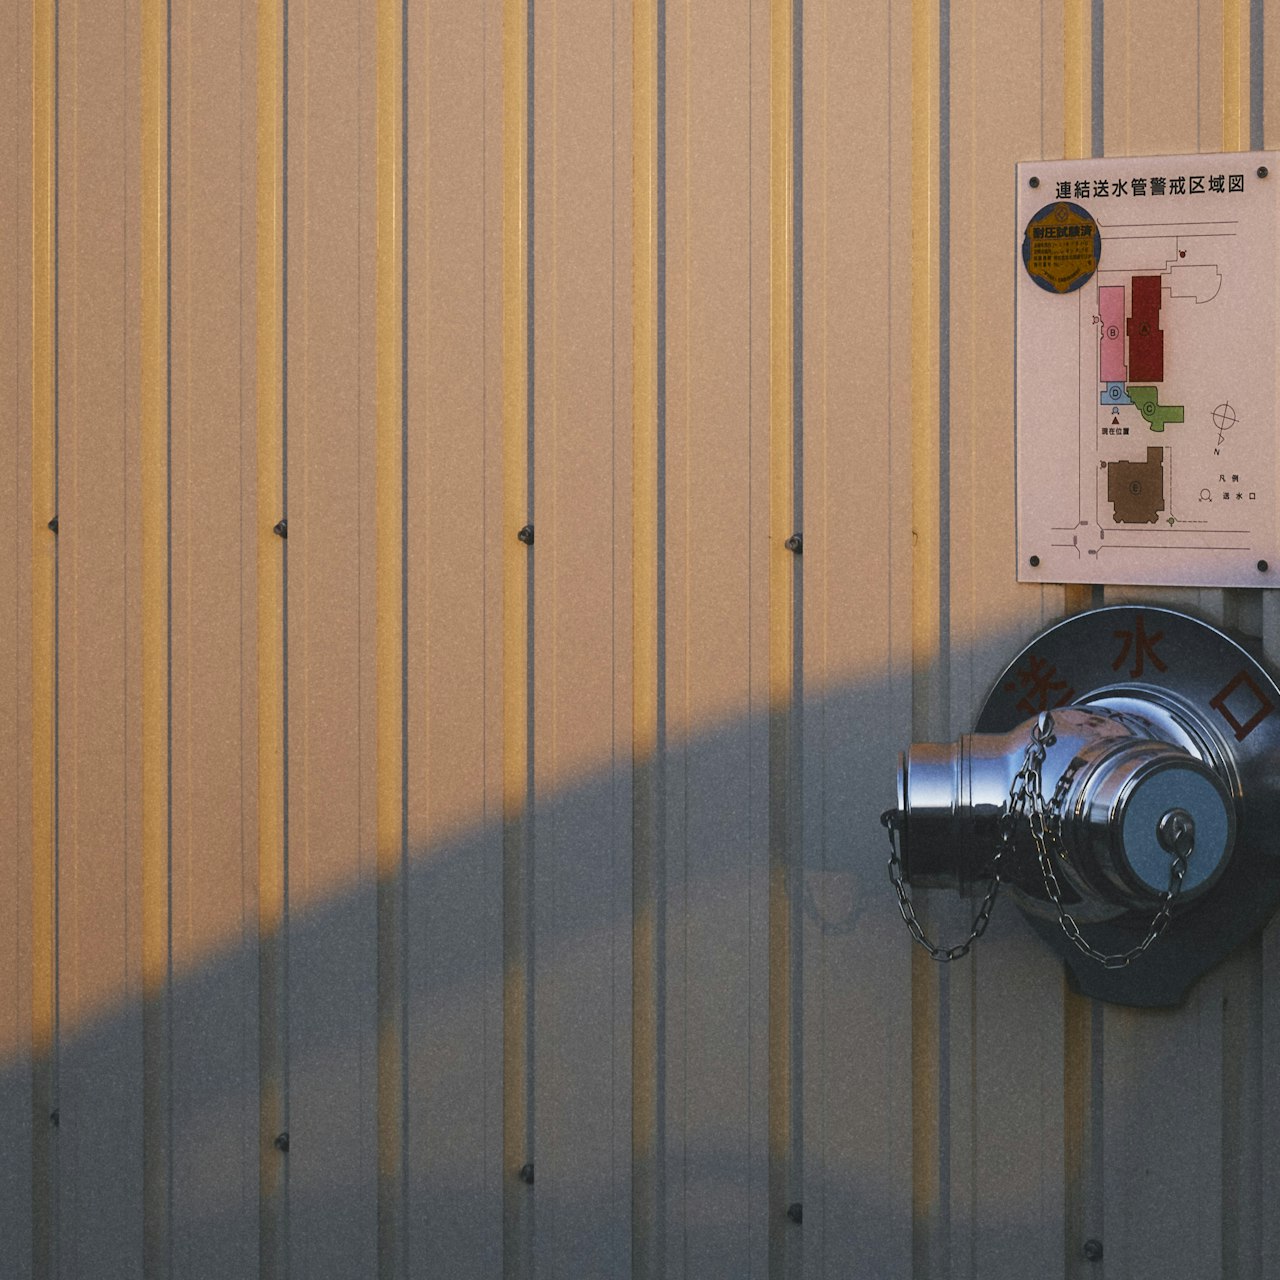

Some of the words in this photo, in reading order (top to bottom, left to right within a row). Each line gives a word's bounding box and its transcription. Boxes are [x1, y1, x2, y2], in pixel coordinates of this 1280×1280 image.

[1055, 174, 1245, 200] 連結送水管警戒区域図
[1101, 427, 1130, 436] 現在位置
[1213, 448, 1220, 456] N
